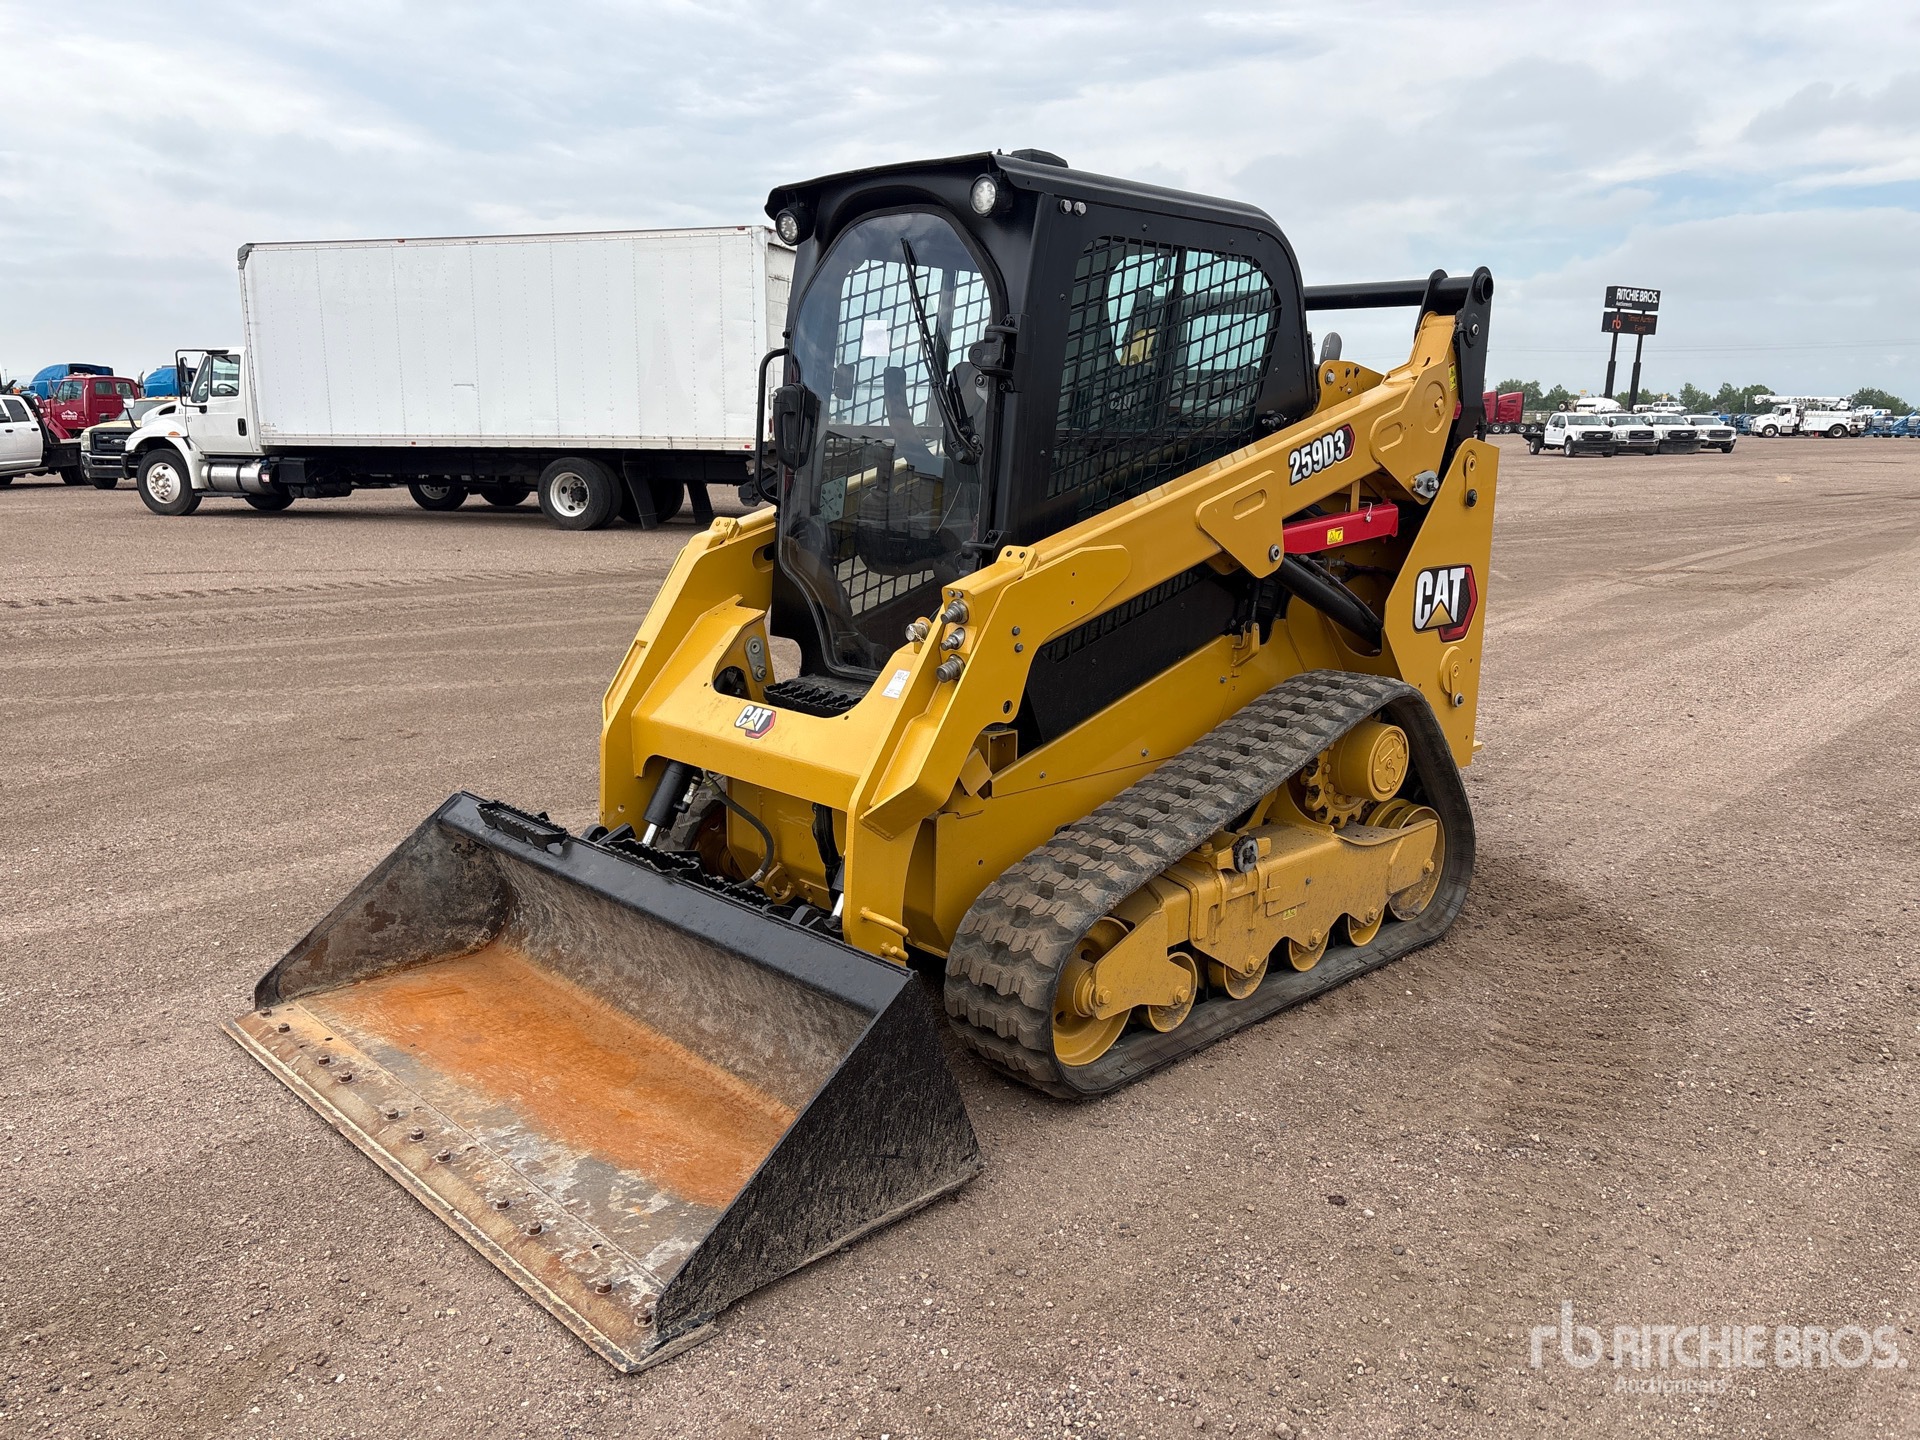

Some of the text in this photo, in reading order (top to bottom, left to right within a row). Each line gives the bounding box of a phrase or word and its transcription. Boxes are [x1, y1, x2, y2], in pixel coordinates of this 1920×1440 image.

[1616, 288, 1658, 303] RITCHIE BROS.
[1289, 429, 1346, 484] 259D3
[1414, 567, 1466, 630] CAT
[735, 705, 772, 731] CAT
